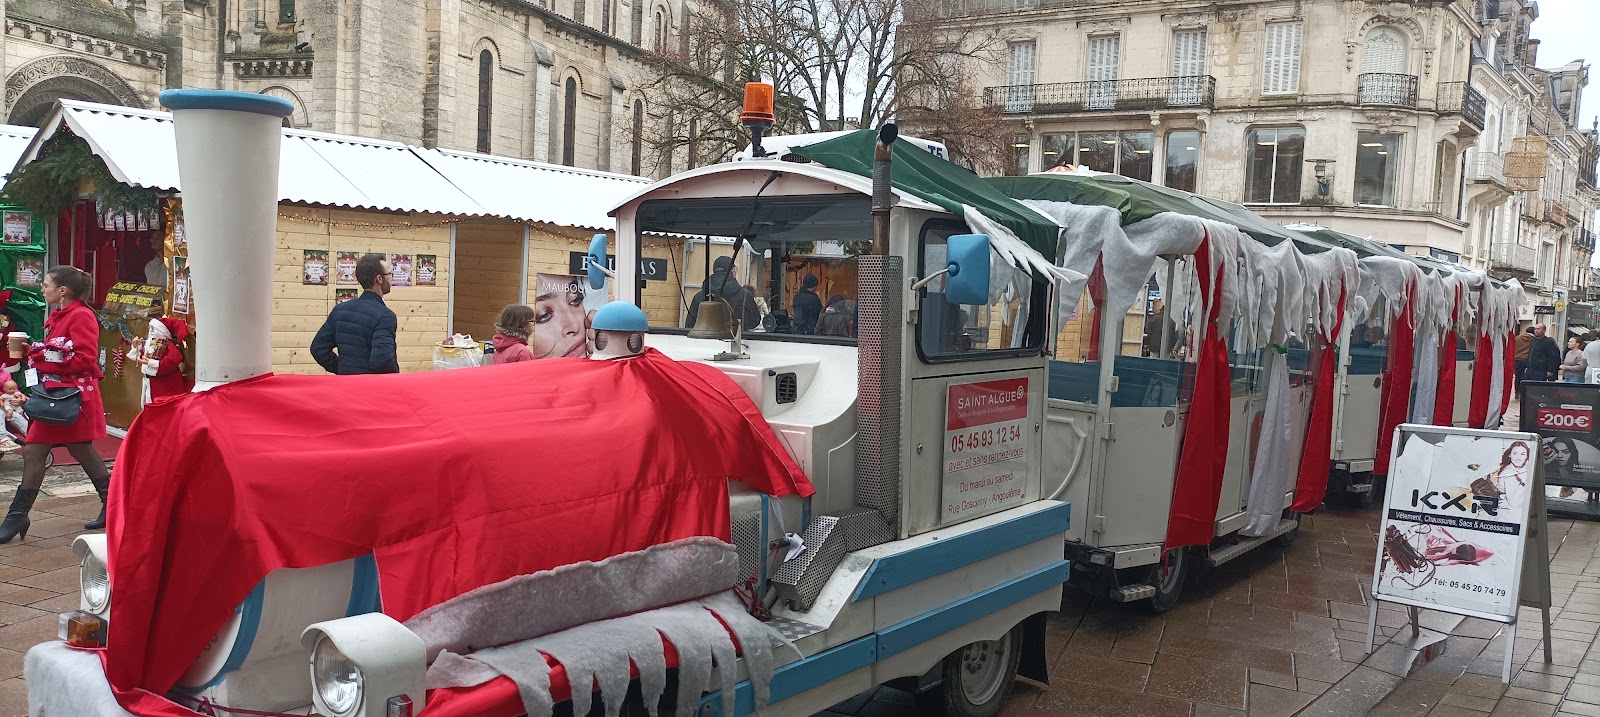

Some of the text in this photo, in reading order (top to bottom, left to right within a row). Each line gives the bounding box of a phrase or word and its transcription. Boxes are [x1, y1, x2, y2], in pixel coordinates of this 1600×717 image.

[928, 145, 942, 160] T5
[958, 391, 1016, 409] SAINT ALGUE
[952, 425, 1020, 452] 05 45 93 12 54
[949, 448, 1023, 471] avec et sans rendez-vous
[960, 471, 1013, 492] Du mardi au samedi
[949, 505, 960, 514] Rue
[962, 497, 987, 511] Goscinny
[992, 488, 1021, 503] Angoulême
[1411, 489, 1498, 516] KXR
[1459, 519, 1472, 527] Sacs
[1479, 522, 1513, 533] Accessoires
[1434, 577, 1447, 587] Tél:
[1496, 589, 1506, 597] 79
